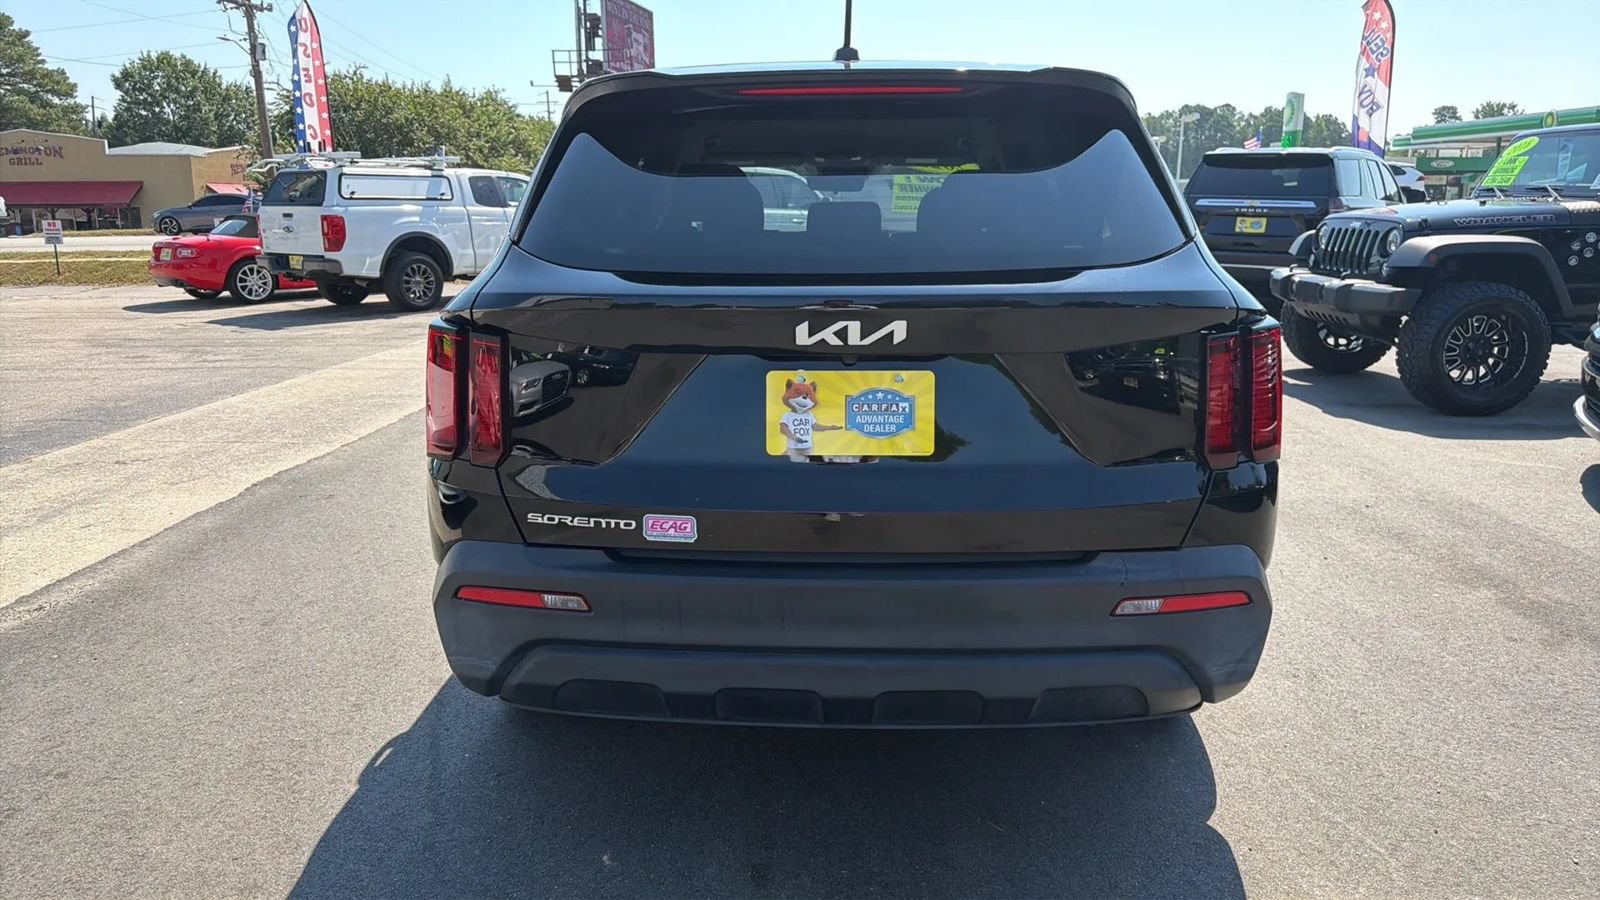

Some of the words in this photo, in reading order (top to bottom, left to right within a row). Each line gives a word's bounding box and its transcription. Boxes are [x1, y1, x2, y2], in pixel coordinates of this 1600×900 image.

[8, 157, 43, 166] GRILL
[1453, 214, 1556, 228] WRANGLER
[795, 320, 908, 346] KIA
[852, 402, 909, 414] CARFAX
[792, 418, 810, 427] CAR
[855, 414, 905, 424] ADVANTAGE
[793, 427, 810, 437] FOX
[863, 423, 897, 433] DEALER
[526, 512, 637, 530] SORENTO
[649, 520, 690, 534] ECAG
